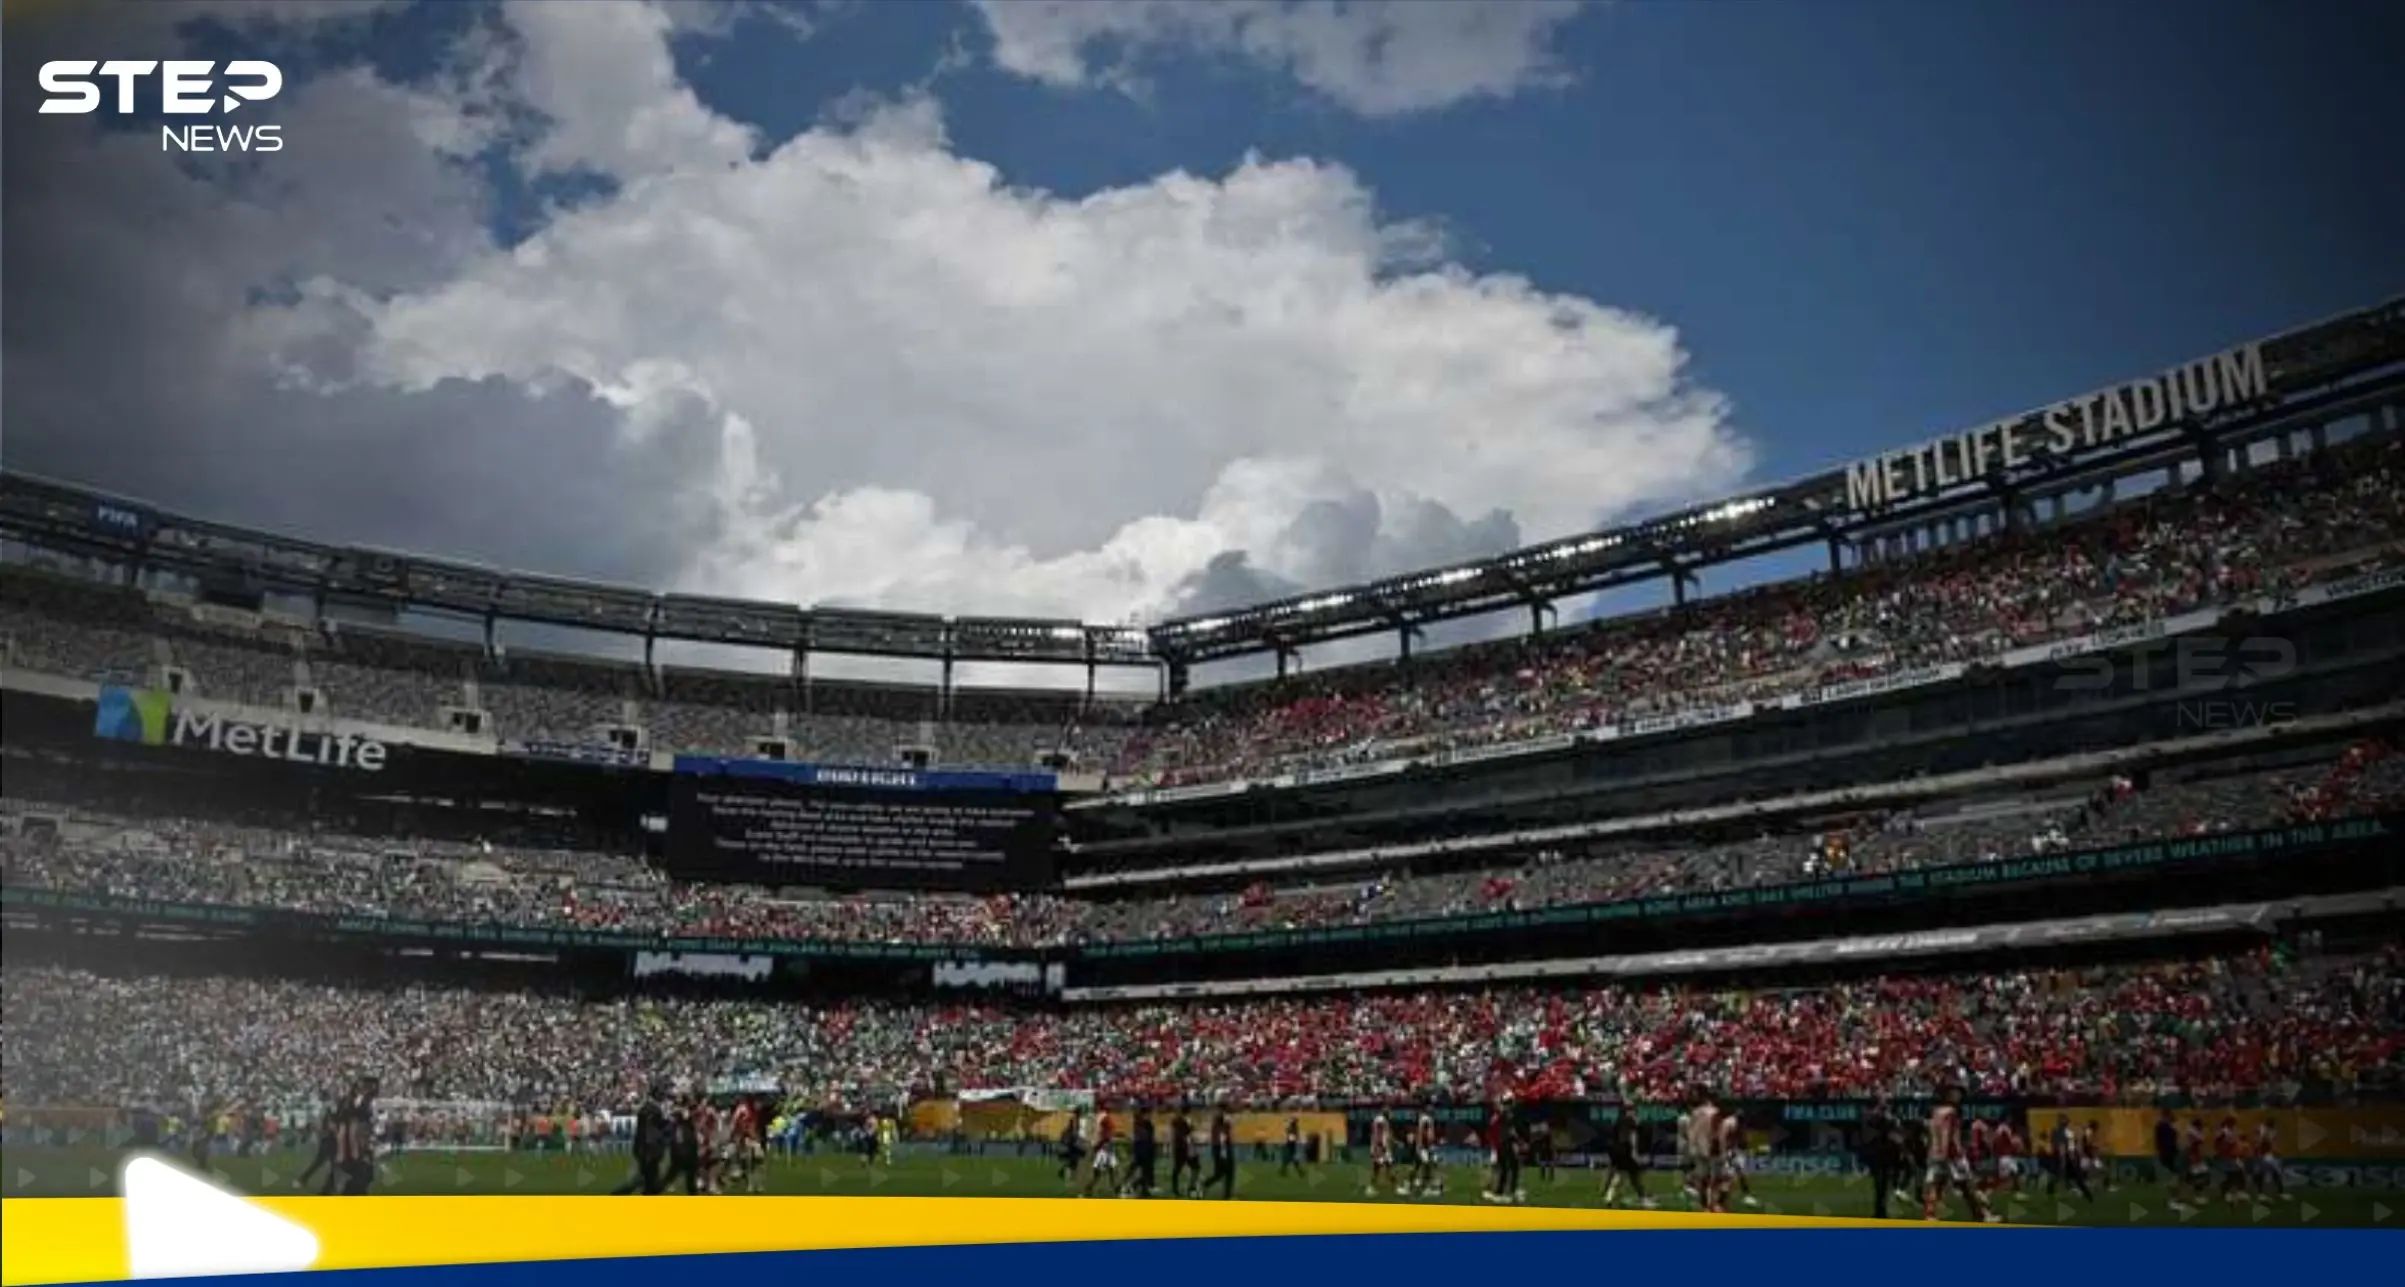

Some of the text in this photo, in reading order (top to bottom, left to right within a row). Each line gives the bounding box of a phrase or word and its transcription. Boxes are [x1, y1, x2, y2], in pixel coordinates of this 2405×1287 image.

[1846, 342, 2267, 511] METLIFE STADIUM
[171, 706, 387, 771] MetLife
[2001, 856, 2071, 879] BECAUSE
[2075, 852, 2098, 870] OF
[2169, 834, 2257, 858] WEATHER
[2260, 829, 2283, 849] IN
[2291, 823, 2325, 845] THE
